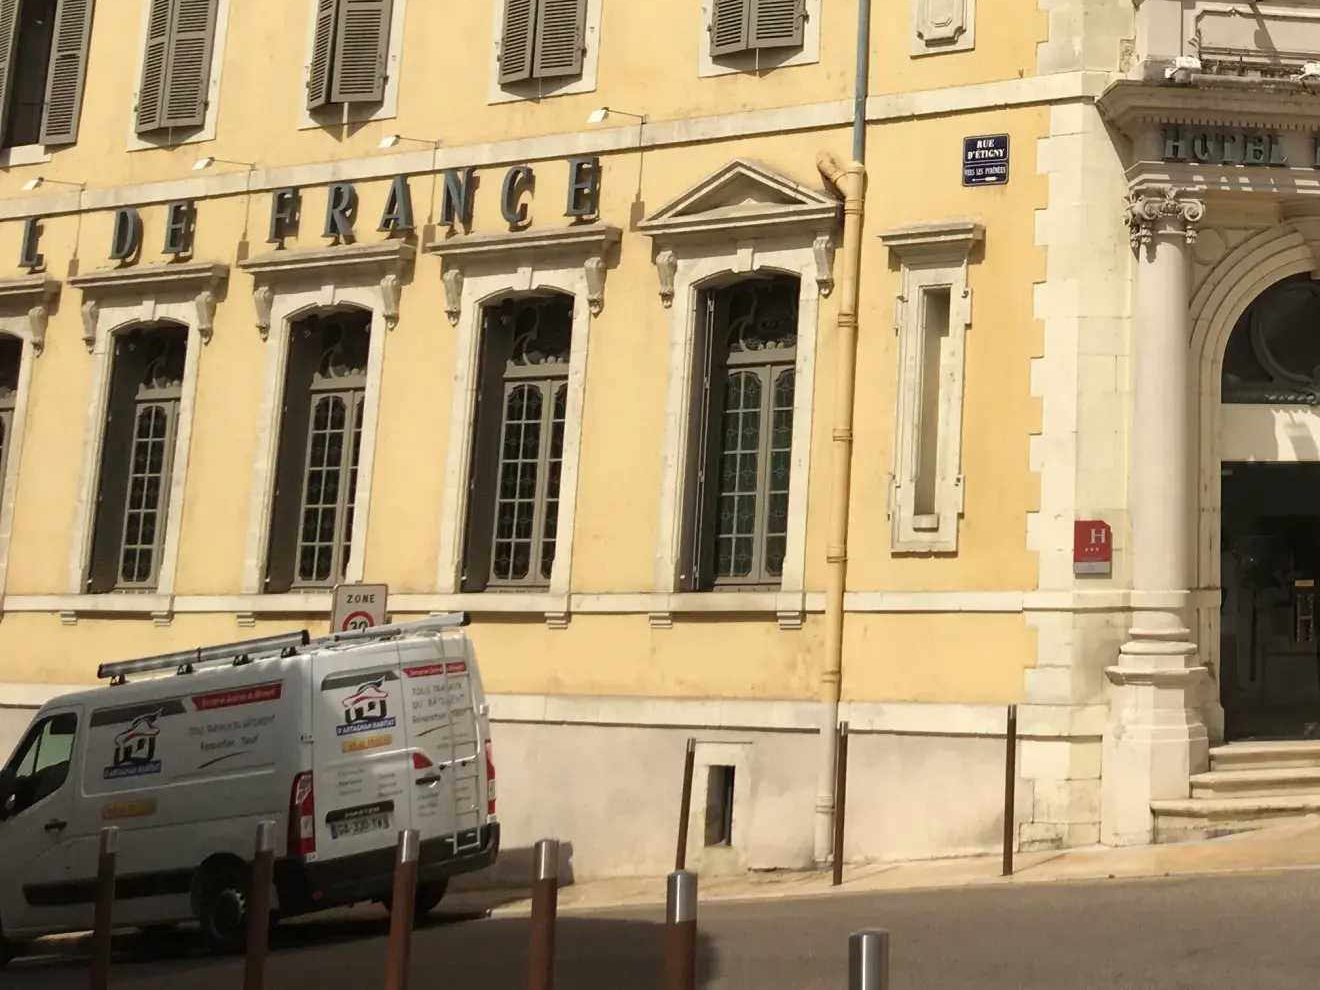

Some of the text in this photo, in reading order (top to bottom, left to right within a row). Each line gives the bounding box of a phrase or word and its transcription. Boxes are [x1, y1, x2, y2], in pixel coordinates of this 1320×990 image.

[977, 139, 994, 148] RUE
[967, 149, 1005, 160] D'ÉTIGNY
[109, 200, 196, 260] DE
[266, 156, 601, 244] FRANCE
[1091, 528, 1106, 544] H
[346, 594, 376, 604] ZONE
